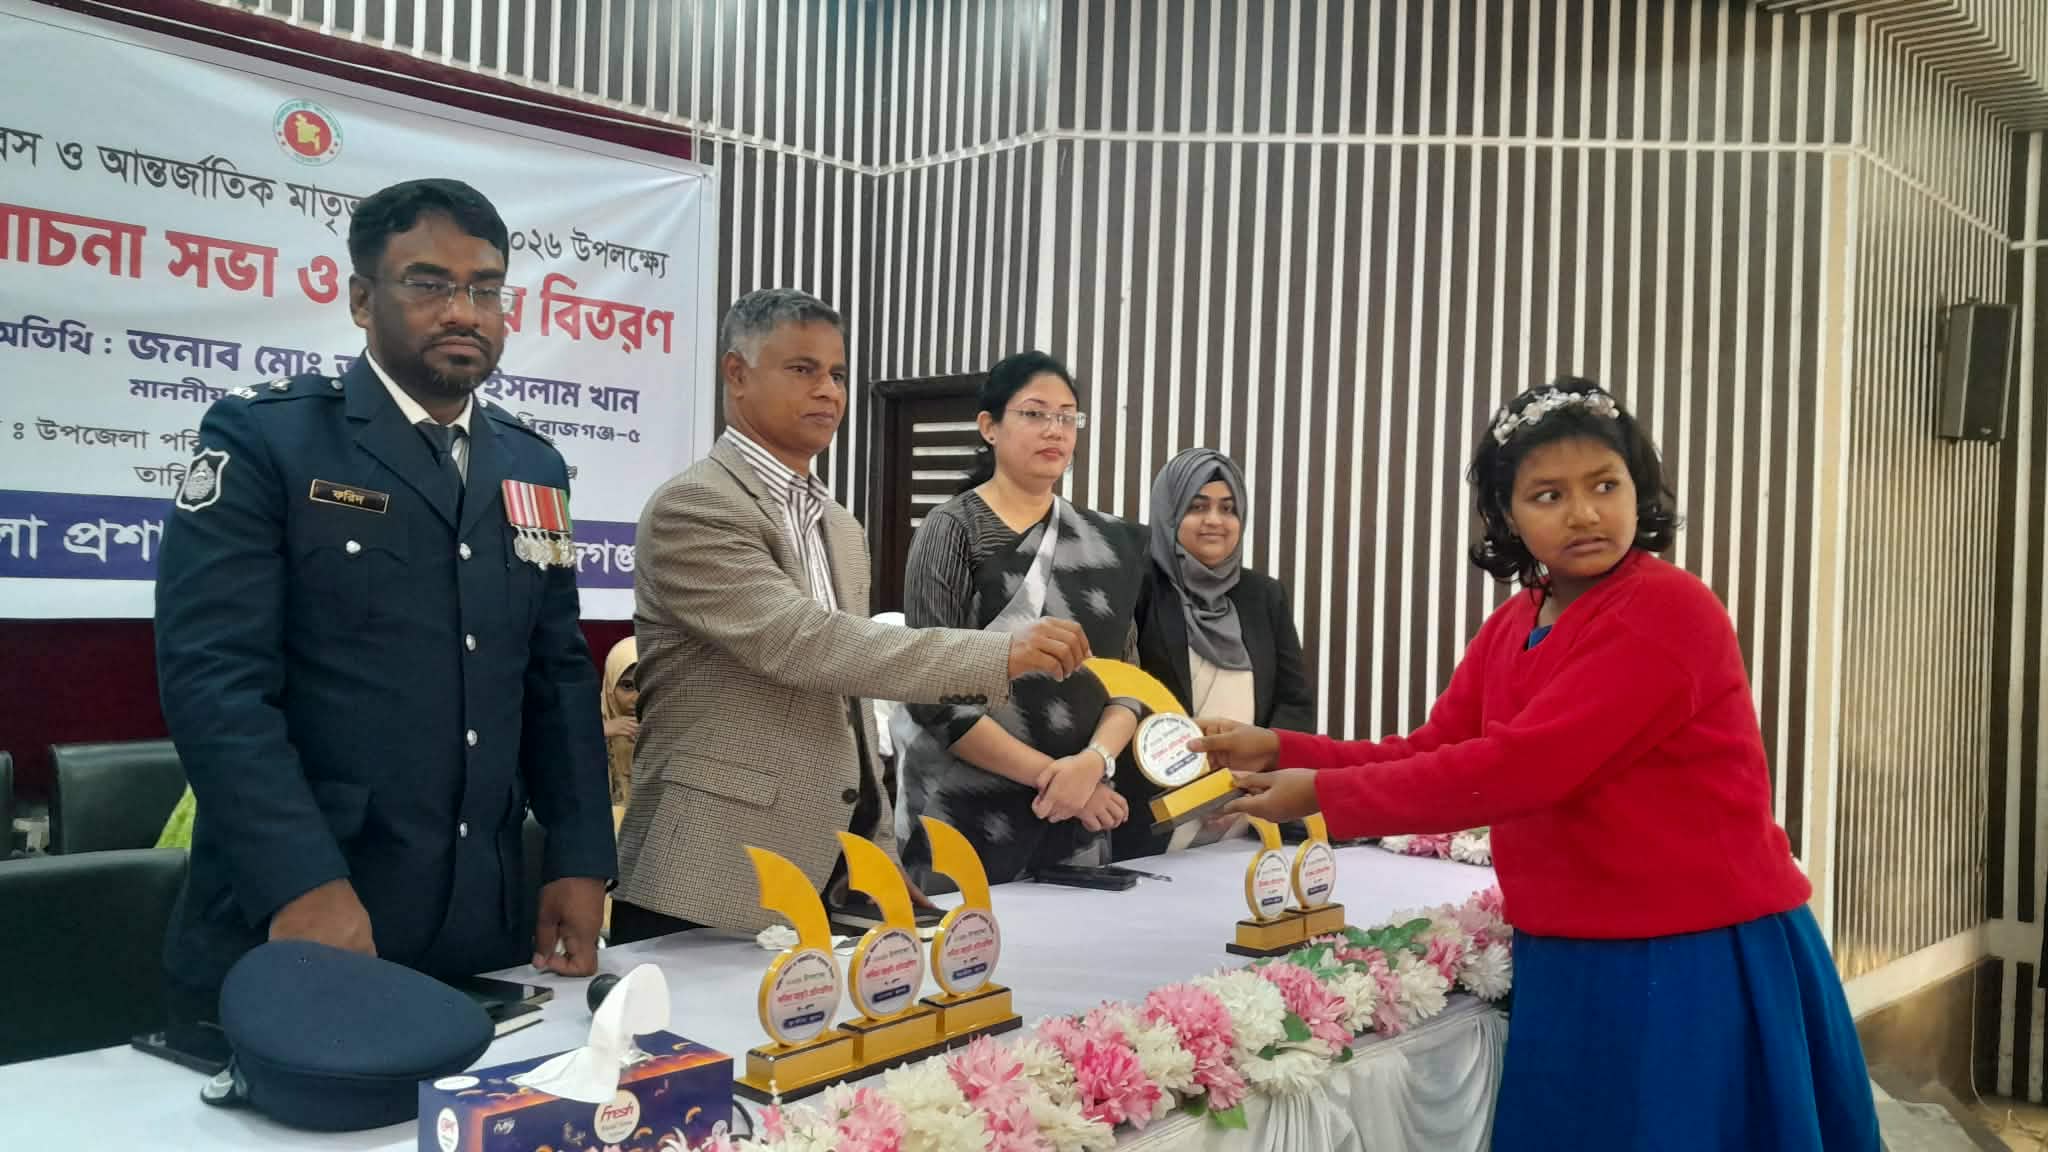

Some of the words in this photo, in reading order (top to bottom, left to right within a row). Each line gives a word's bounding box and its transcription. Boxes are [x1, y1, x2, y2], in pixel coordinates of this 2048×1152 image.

[0, 126, 43, 167] স
[56, 141, 83, 171] ও
[96, 145, 278, 207] আন্তর্জাতিক
[510, 229, 562, 261] ০২৬
[165, 230, 279, 298] সভা
[297, 255, 339, 304] ও
[540, 272, 674, 354] বিতরণ
[126, 329, 242, 372] জনাব
[588, 386, 640, 414] খান
[35, 417, 150, 450] উপজেলা
[600, 1102, 634, 1121] Fresh
